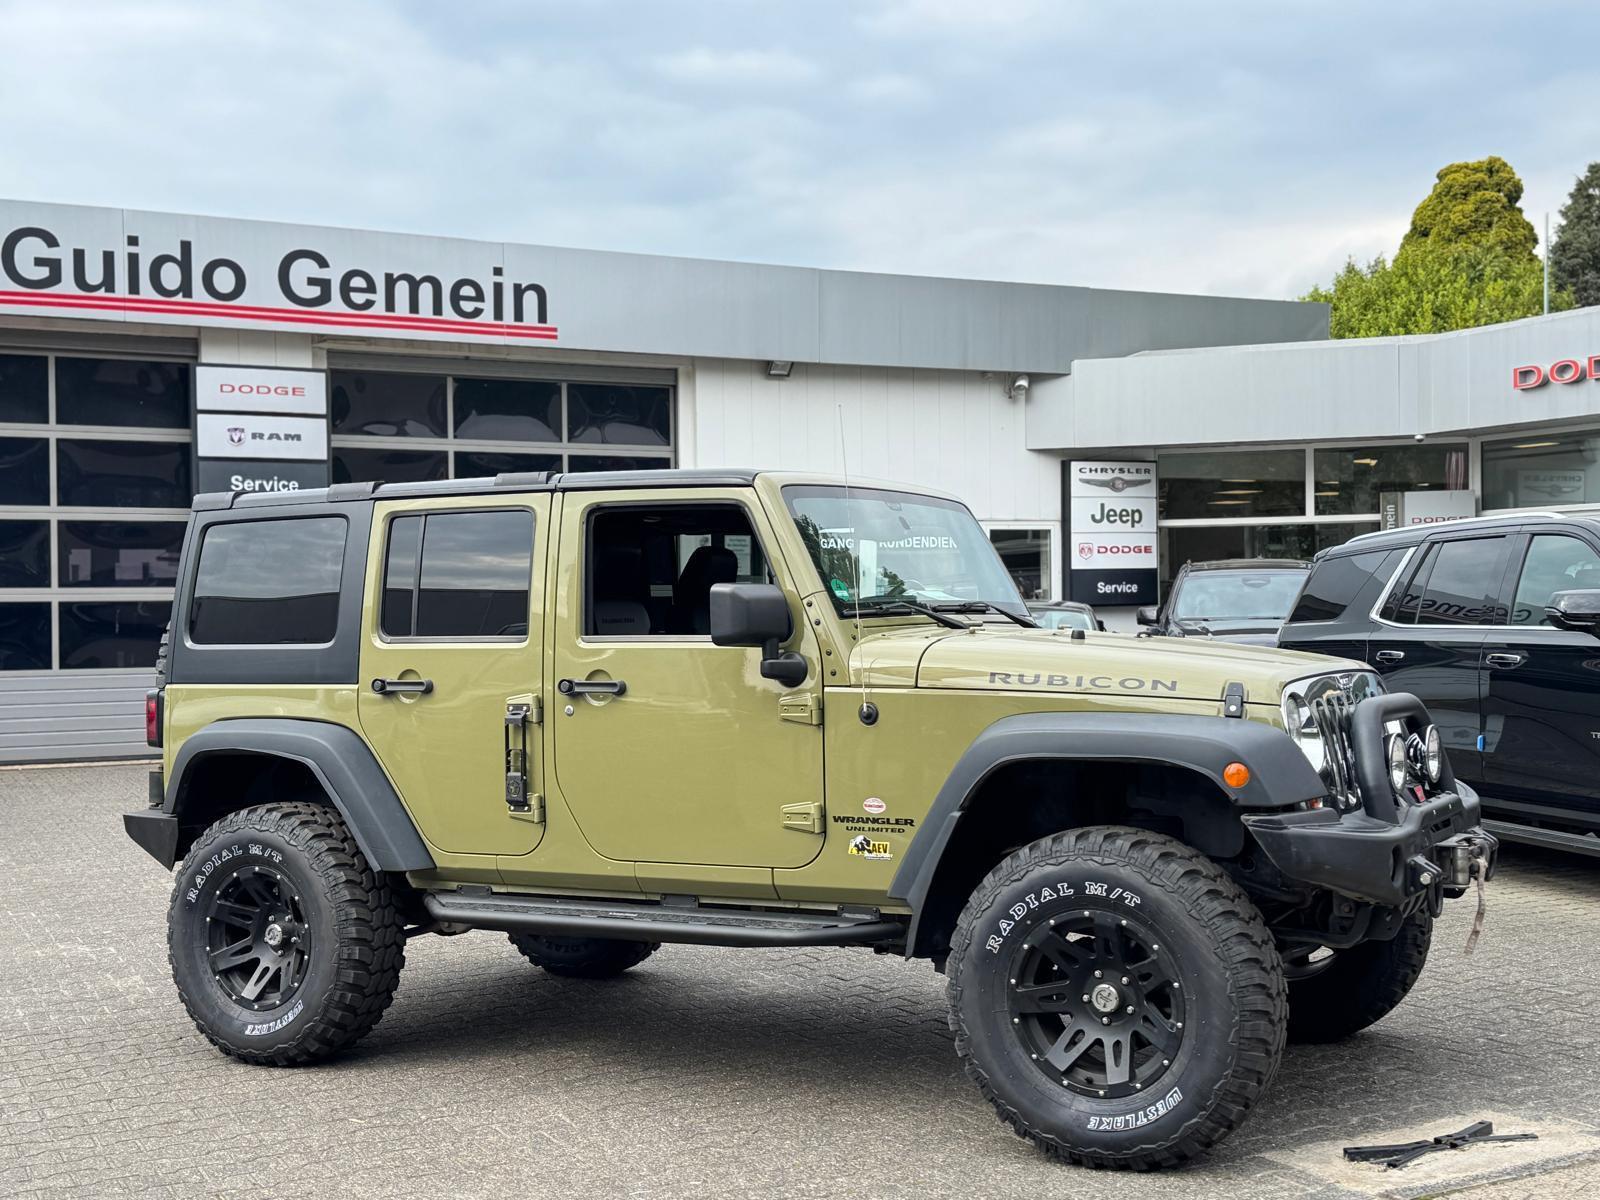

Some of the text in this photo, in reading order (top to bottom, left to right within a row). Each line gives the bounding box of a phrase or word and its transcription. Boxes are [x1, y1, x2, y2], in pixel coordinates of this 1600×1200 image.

[1, 227, 548, 324] Guido Gemein
[220, 384, 306, 396] DODGE
[251, 432, 302, 441] RAM
[1078, 467, 1151, 475] CHRYSLER
[230, 475, 299, 491] Service
[1091, 503, 1143, 528] Jeep
[1411, 516, 1470, 524] DODG
[1097, 545, 1153, 554] DODGE
[1097, 582, 1138, 593] Service
[989, 672, 1178, 692] RUBICON
[832, 816, 915, 827] WRANGLER
[871, 843, 888, 854] AEV
[187, 845, 243, 903] RADIAL
[986, 881, 1141, 954] RADIAL M/T
[1087, 1086, 1183, 1131] WESTLAKE
